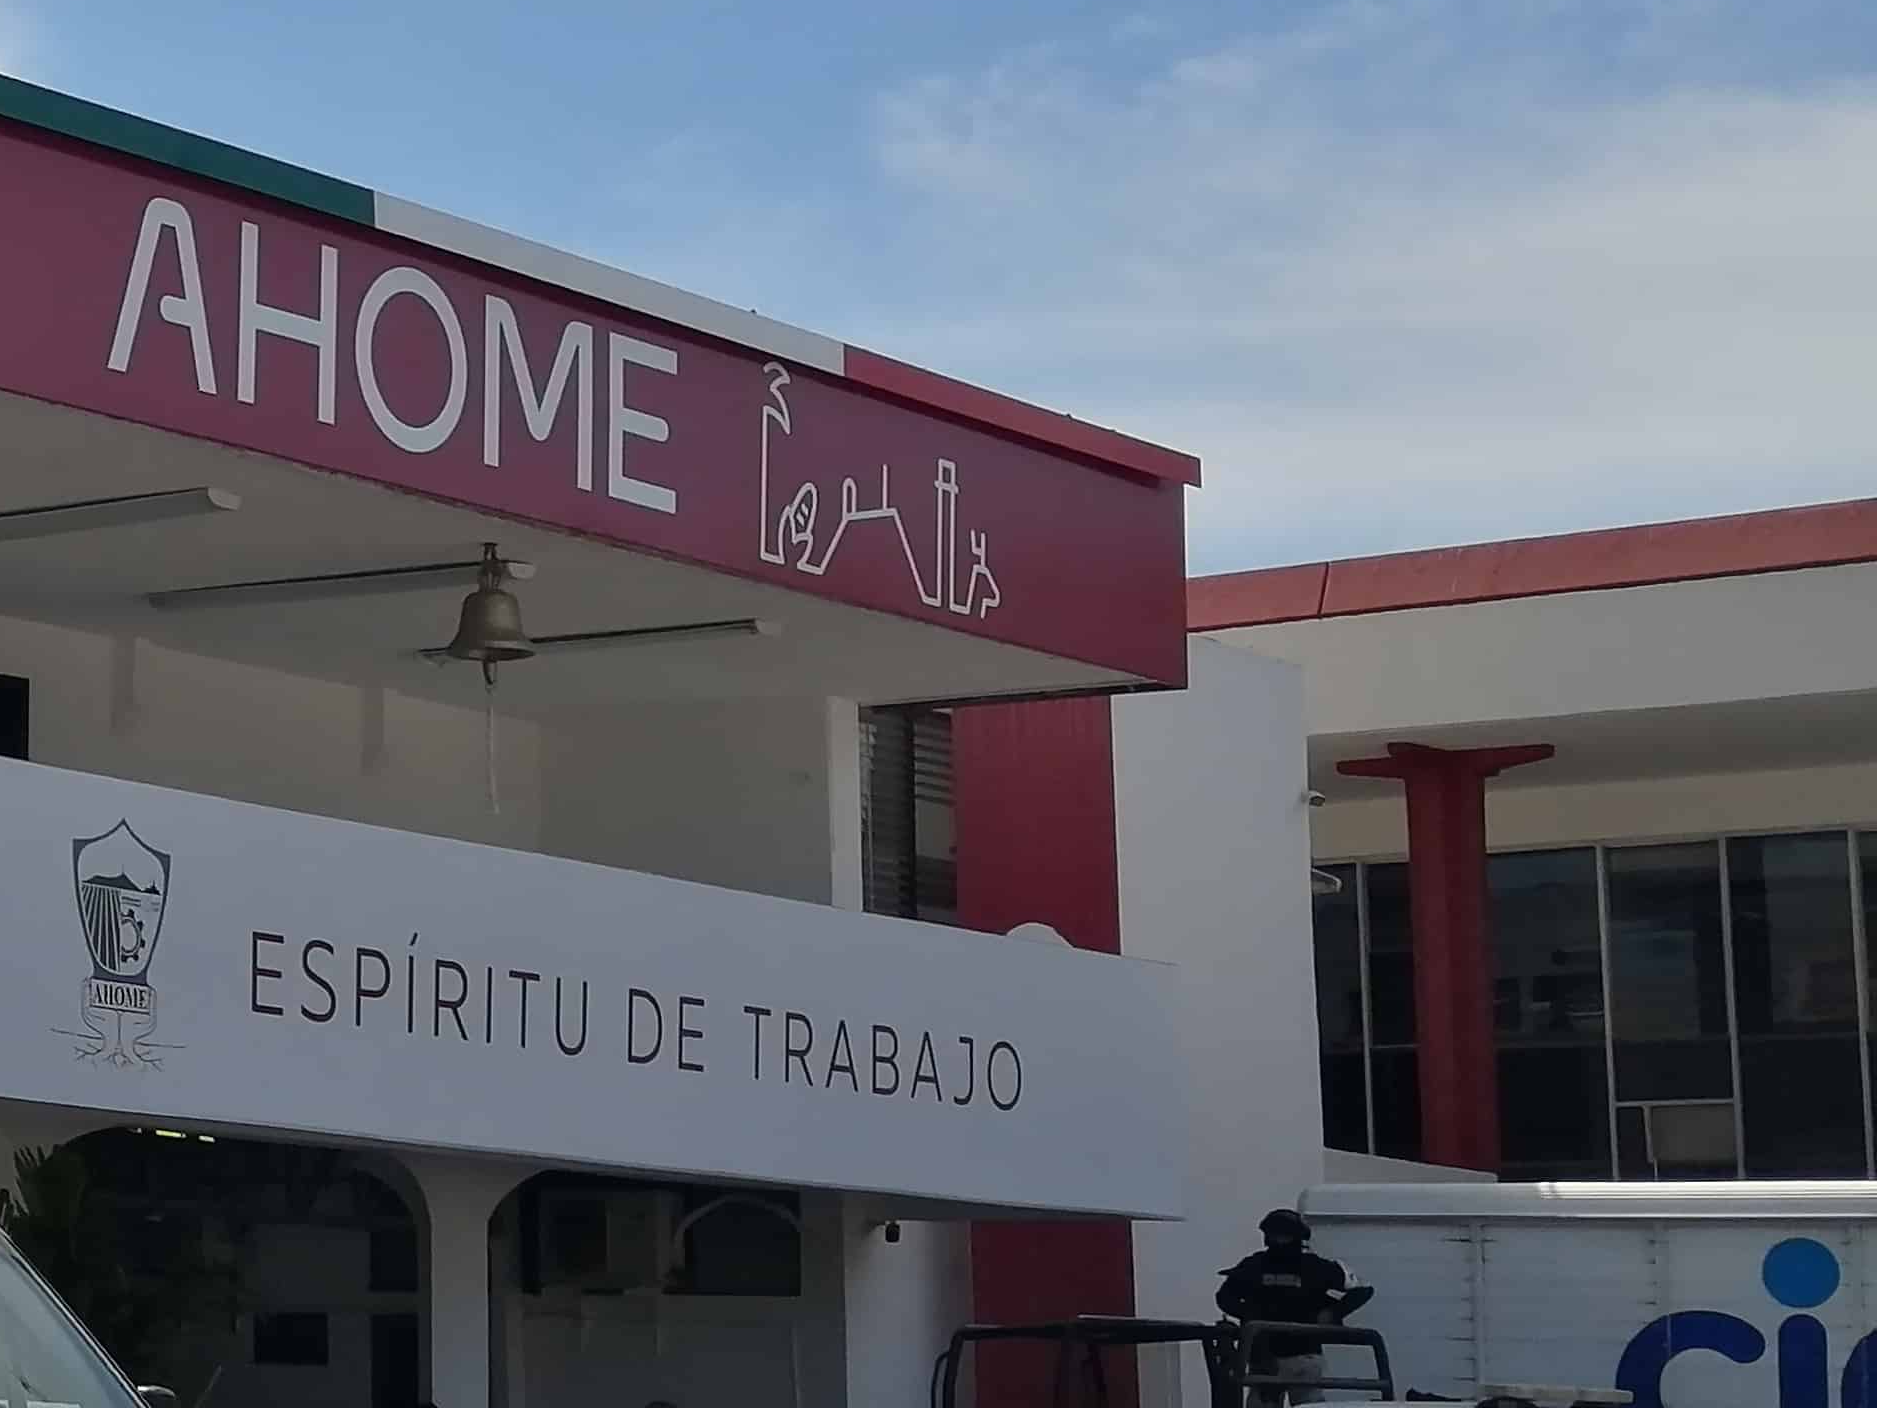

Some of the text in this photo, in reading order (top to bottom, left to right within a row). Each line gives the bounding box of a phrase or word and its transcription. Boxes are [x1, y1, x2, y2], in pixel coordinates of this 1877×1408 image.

[107, 197, 678, 515] AHOME
[251, 932, 1024, 1112] ESPÍRITU DE TRABAJO
